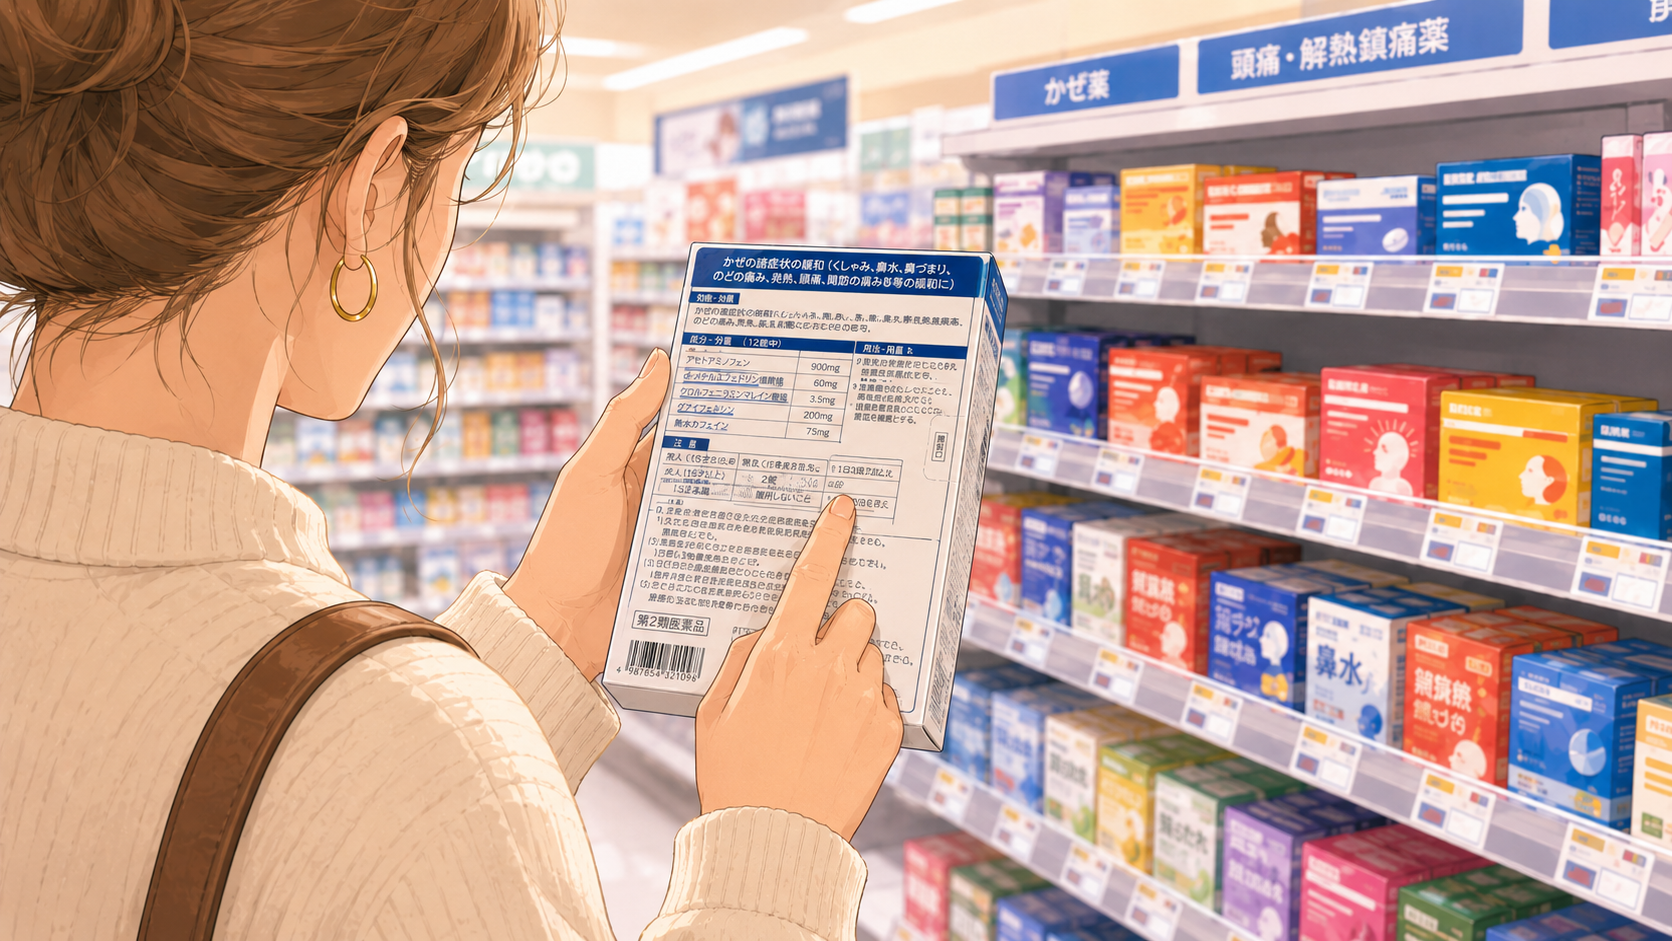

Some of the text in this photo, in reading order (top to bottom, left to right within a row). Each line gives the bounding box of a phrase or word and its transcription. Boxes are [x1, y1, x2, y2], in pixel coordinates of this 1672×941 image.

[1230, 16, 1450, 80] 頭痛・解熱鎮痛薬
[1044, 69, 1110, 106] かぜ薬
[811, 362, 841, 373] 900mg
[813, 378, 838, 389] 60mg
[809, 395, 836, 406] 3.5mg
[803, 411, 833, 422] 200mg
[806, 427, 830, 438] 75mg
